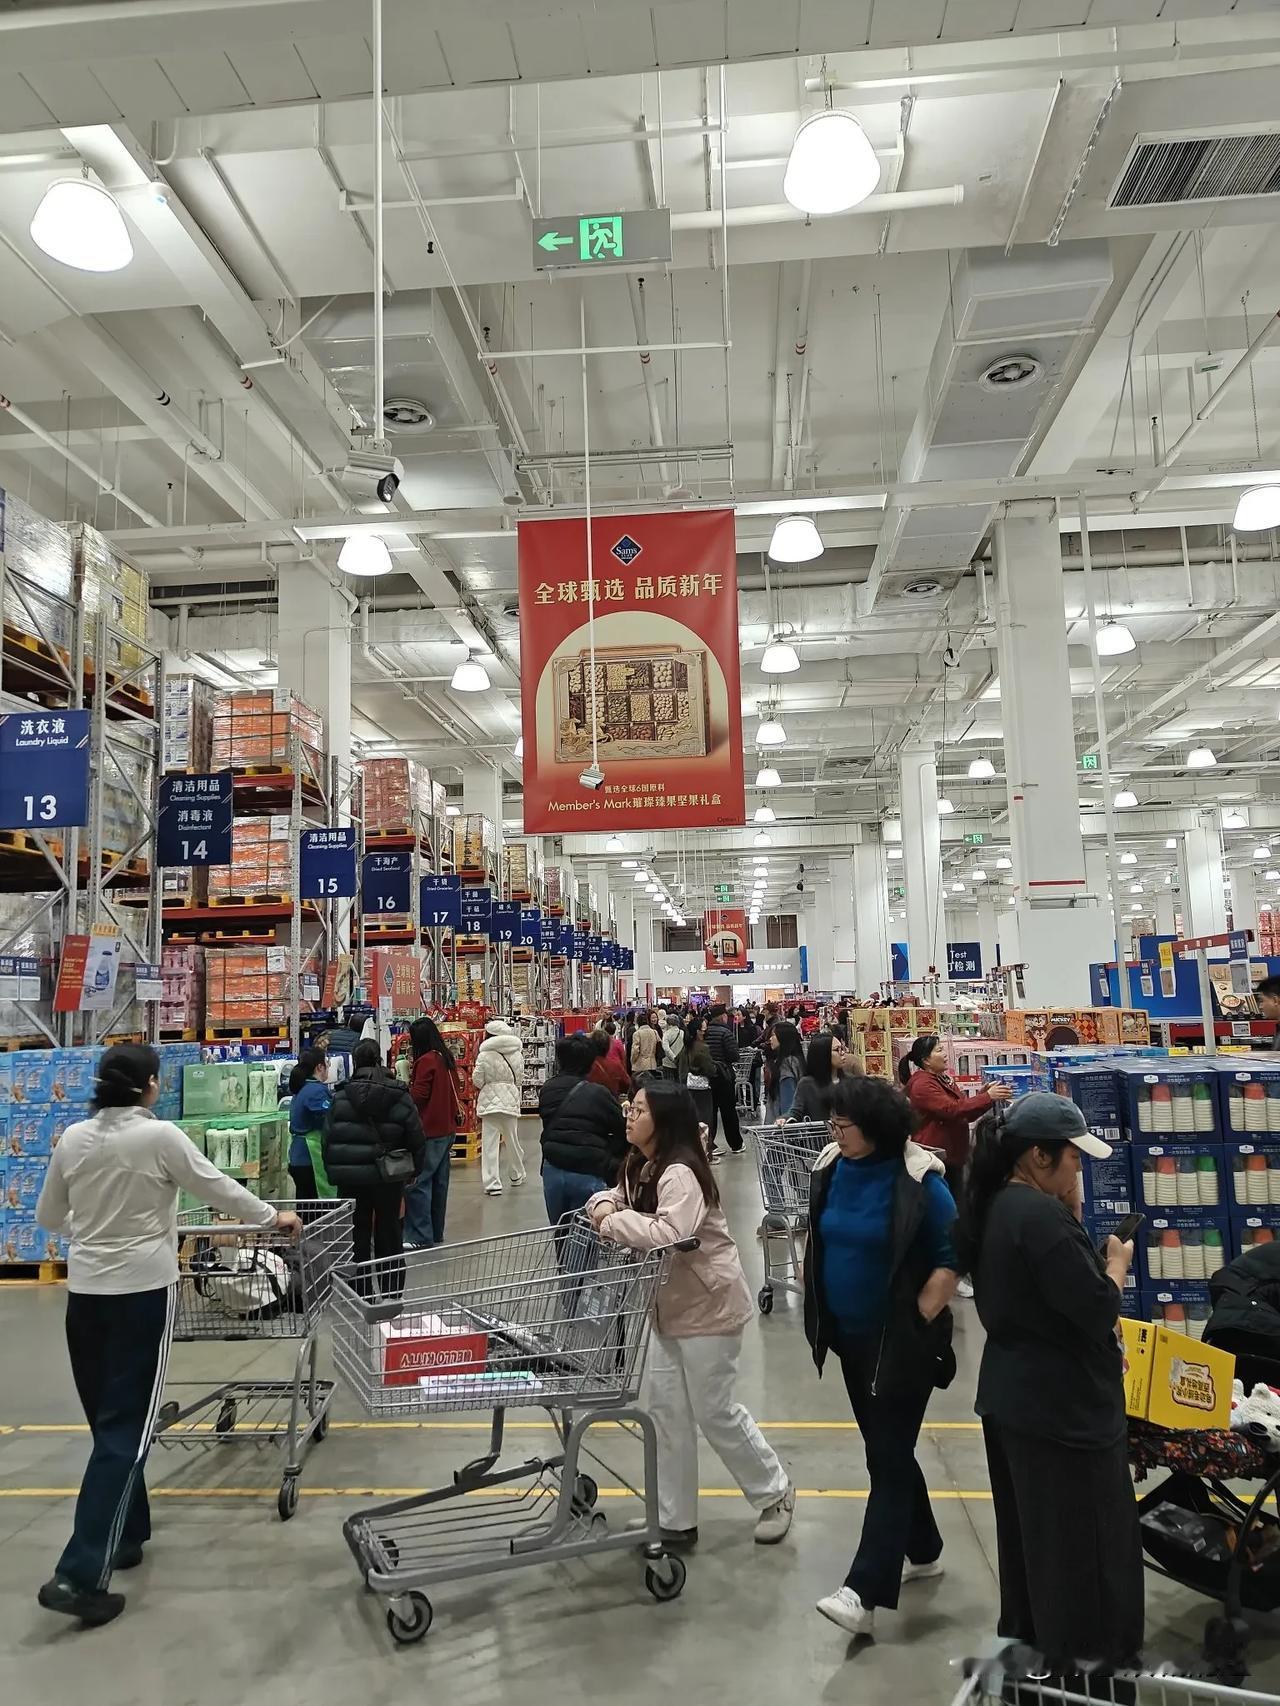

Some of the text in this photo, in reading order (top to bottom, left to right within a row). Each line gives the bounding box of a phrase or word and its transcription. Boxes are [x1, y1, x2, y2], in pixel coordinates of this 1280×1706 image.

[534, 573, 724, 605] 全球甄选 品质新年
[20, 718, 66, 736] 洗衣液
[16, 736, 68, 747] Laundry Liquid
[172, 780, 220, 793] 清洁用品
[170, 794, 221, 802] Cleaning Supplies
[24, 794, 57, 820] 13
[548, 800, 600, 812] Member's
[178, 809, 213, 822] 消毒液
[309, 832, 346, 843] 清洁用品
[182, 840, 208, 860] 14
[318, 878, 338, 894] 15
[378, 896, 396, 910] 16
[433, 912, 449, 924] 17
[467, 921, 480, 931] 18
[500, 930, 512, 940] 19
[520, 936, 533, 945] 20
[950, 950, 967, 959] Test
